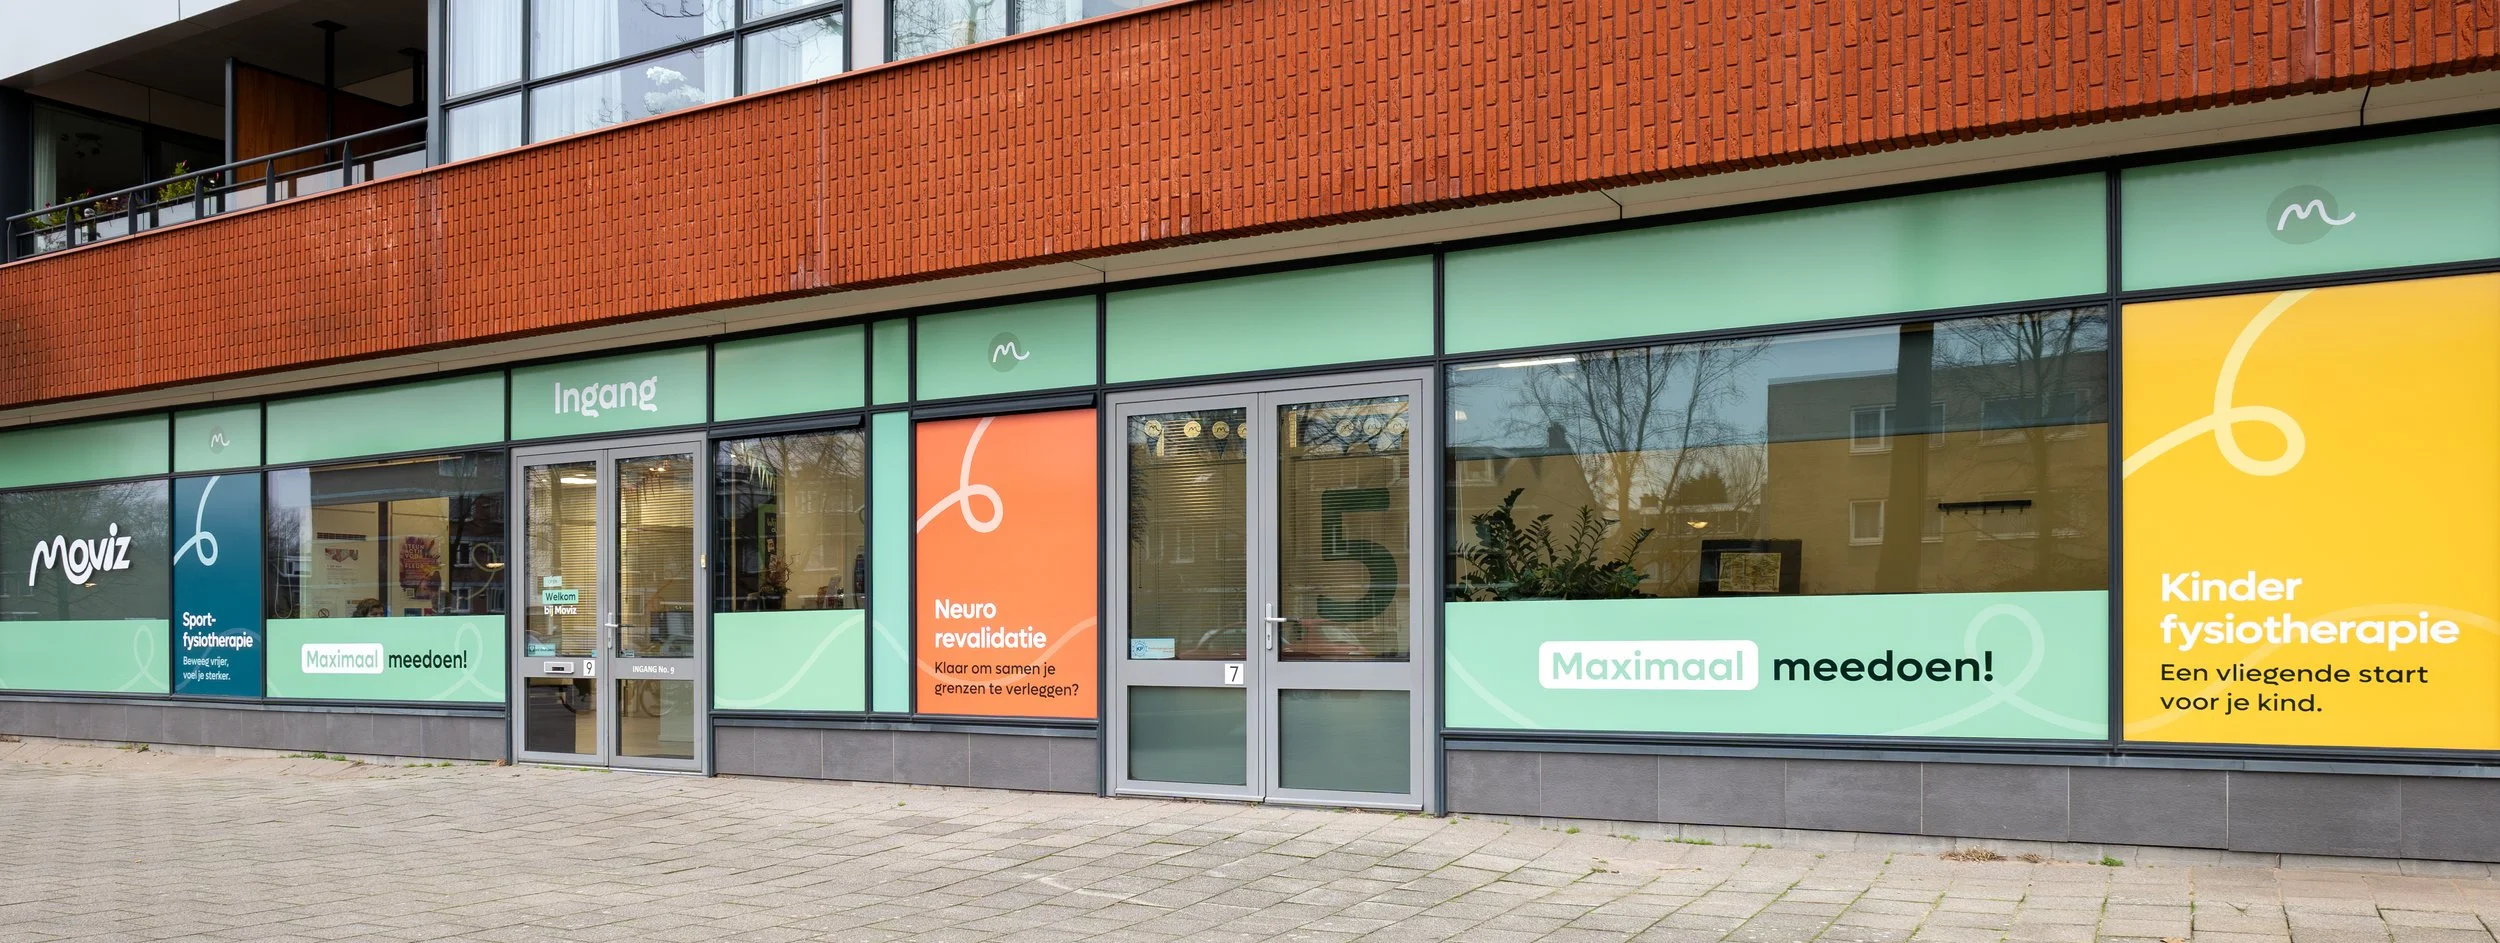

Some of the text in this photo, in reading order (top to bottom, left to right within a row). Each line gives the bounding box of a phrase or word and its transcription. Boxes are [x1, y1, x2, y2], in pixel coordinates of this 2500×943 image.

[554, 376, 657, 417] Ingang
[29, 522, 132, 587] Moviz
[1317, 487, 1398, 622] 5
[2161, 570, 2303, 602] Kinder
[545, 592, 576, 601] Welkom
[544, 605, 577, 617] bij Moviz
[935, 599, 997, 619] Neuro
[182, 611, 217, 630] Sport-
[935, 626, 1047, 649] revalidatie
[2160, 611, 2460, 652] fysiotherapie
[182, 632, 254, 651] fysiotherapie
[183, 656, 229, 668] Beweeg vrijer,
[306, 650, 467, 669] Maximaal meedoen!
[586, 661, 593, 674] 9
[1552, 649, 1994, 683] Maximaal meedoen!
[183, 670, 231, 682] voel je sterker.
[632, 665, 675, 675] INGANG No. 9
[935, 661, 1056, 678] Klaar om samen je
[1229, 665, 1239, 682] 7
[2161, 663, 2429, 687] Een vliegende start
[934, 683, 1079, 698] grenzen te verleggen?
[2160, 692, 2323, 716] voor je kind.
